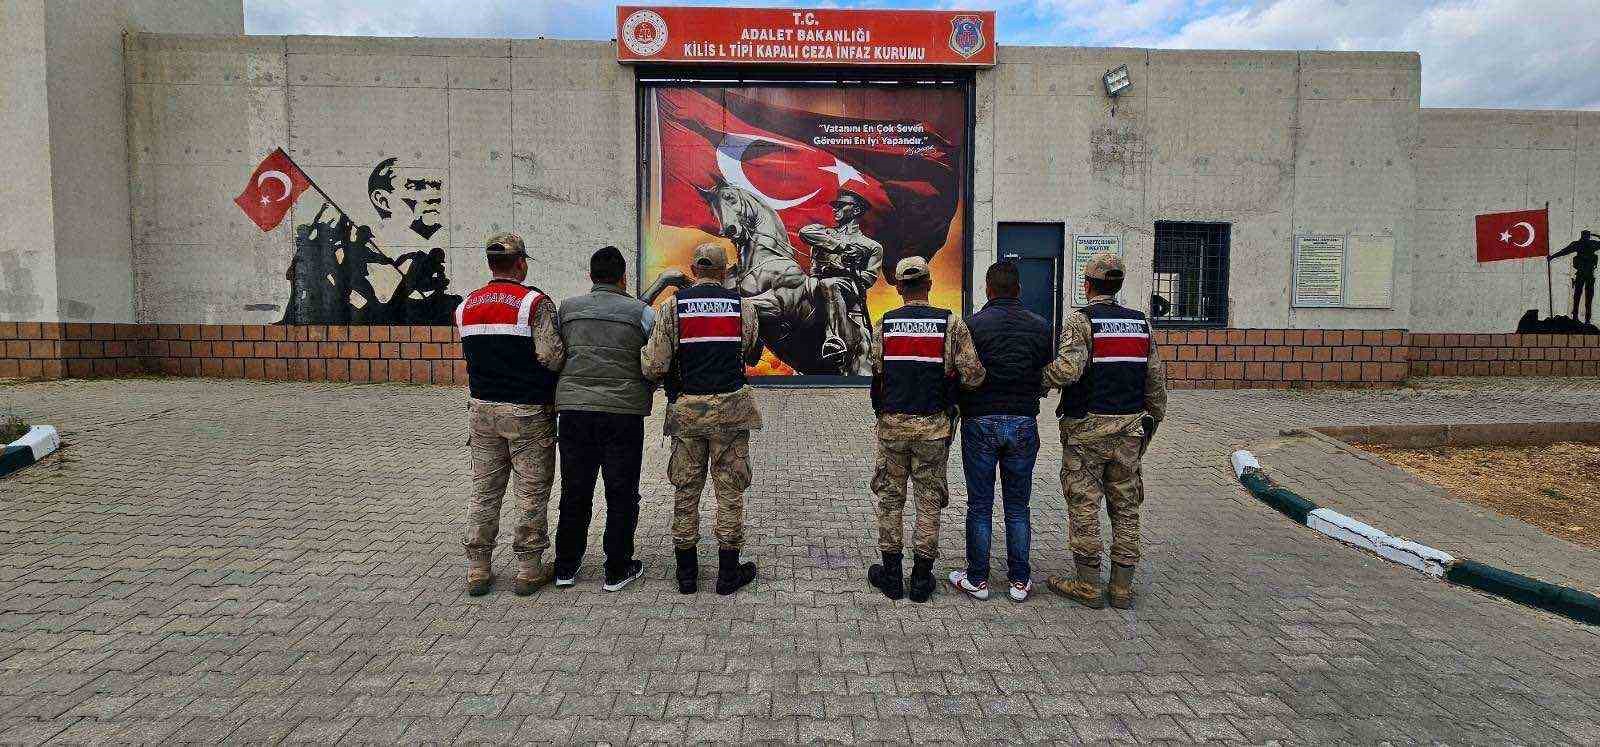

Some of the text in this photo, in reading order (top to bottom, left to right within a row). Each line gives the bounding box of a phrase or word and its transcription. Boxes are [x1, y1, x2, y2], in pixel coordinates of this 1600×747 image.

[792, 12, 819, 26] T.C.
[741, 27, 871, 42] ADALET BAKANLIĞI
[684, 41, 716, 57] KİLİS
[730, 42, 753, 57] TİPİ
[757, 44, 799, 58] KAPALI
[802, 45, 833, 59] CEZA
[836, 43, 871, 59] İNFAZ
[874, 47, 926, 60] KURUMU
[863, 124, 874, 133] En
[813, 136, 852, 145] Görevini
[854, 136, 866, 145] En
[685, 301, 734, 313] JANDARMA
[890, 322, 938, 333] JANDARMA
[1100, 322, 1144, 333] JANDARMA
